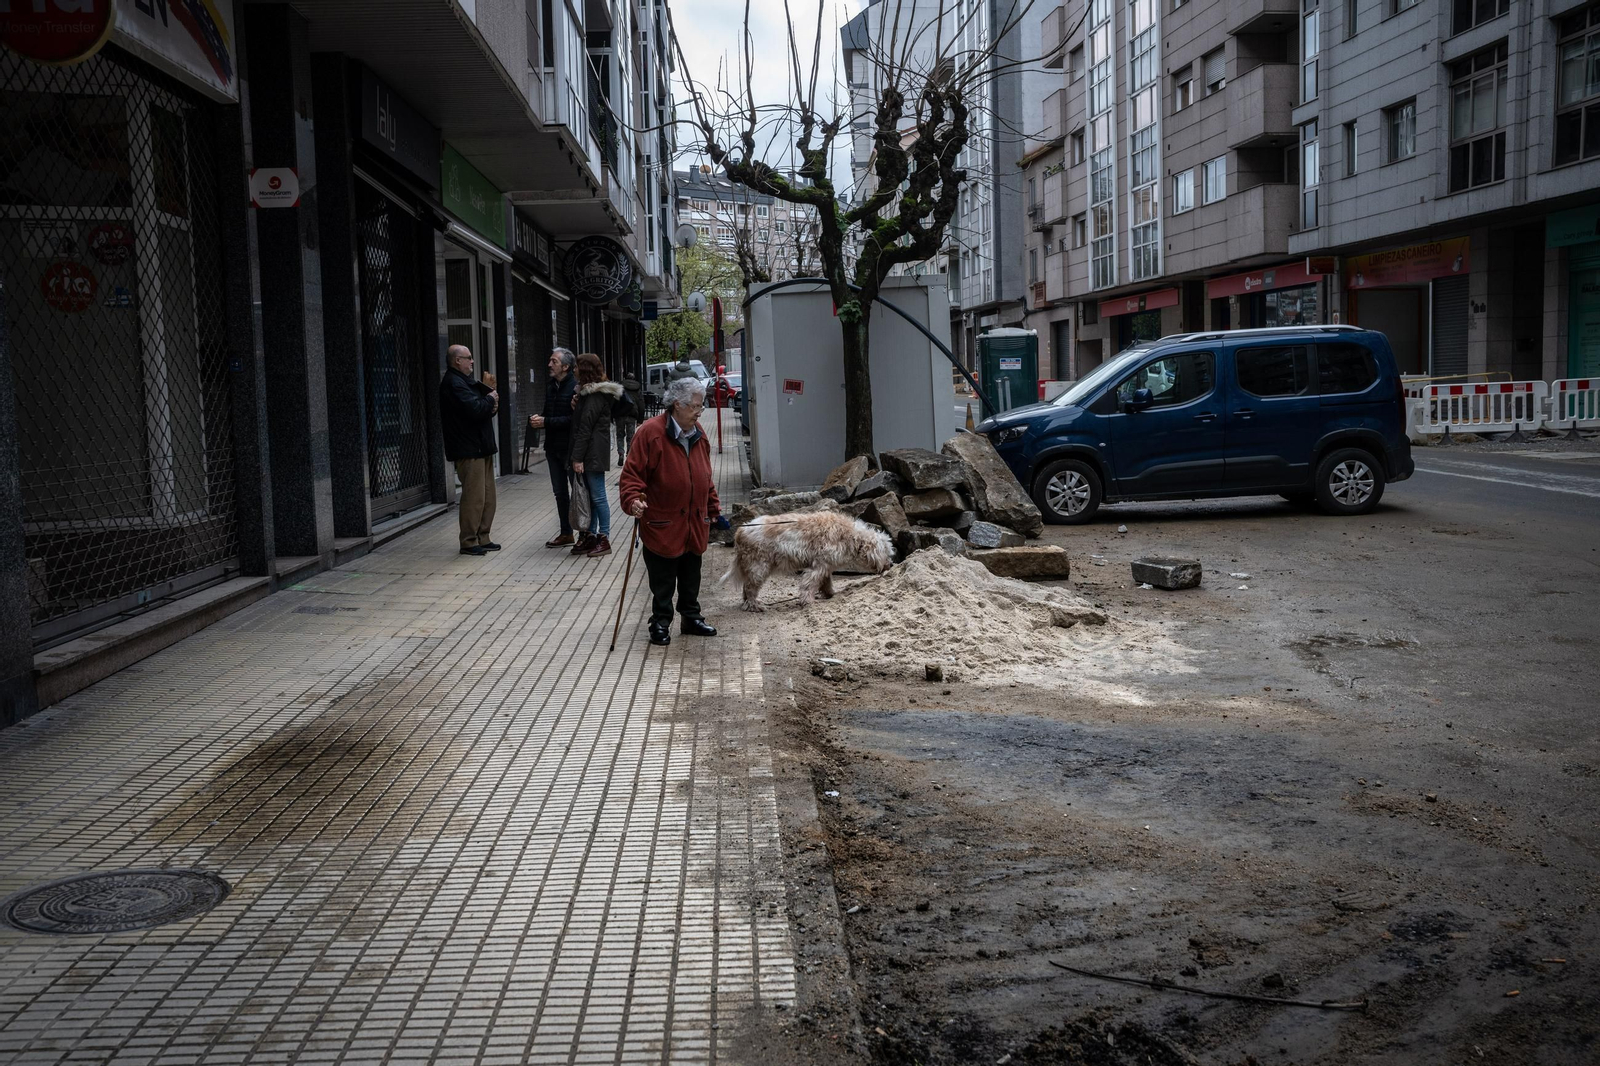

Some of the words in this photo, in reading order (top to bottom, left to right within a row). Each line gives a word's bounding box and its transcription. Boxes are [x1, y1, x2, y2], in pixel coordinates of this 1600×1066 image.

[0, 19, 42, 34] Money
[43, 20, 96, 33] Transfer
[376, 84, 397, 152] laly
[1368, 249, 1406, 267] LIMPIEZAS
[1406, 242, 1443, 260] CANEIRO
[579, 278, 590, 287] EL
[589, 276, 614, 286] GRITO
